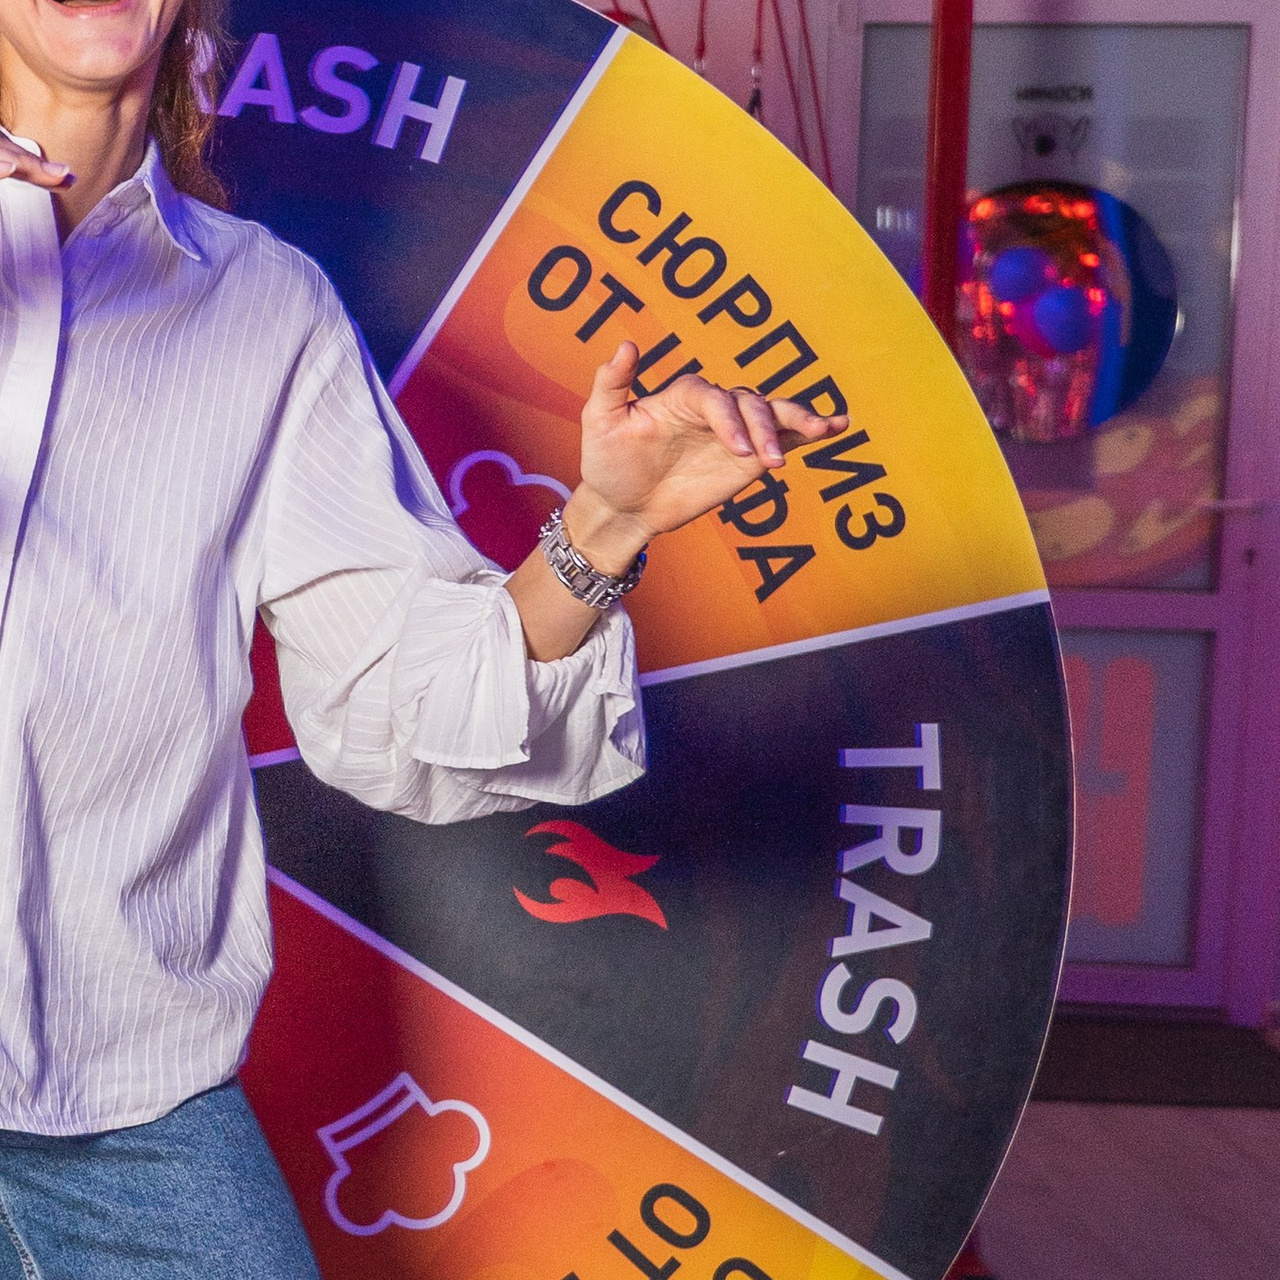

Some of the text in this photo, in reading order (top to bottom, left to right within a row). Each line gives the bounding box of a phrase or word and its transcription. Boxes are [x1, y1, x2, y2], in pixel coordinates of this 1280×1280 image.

[185, 31, 467, 165] ASH
[526, 244, 646, 344] ОТ
[786, 722, 943, 1136] TRASH
